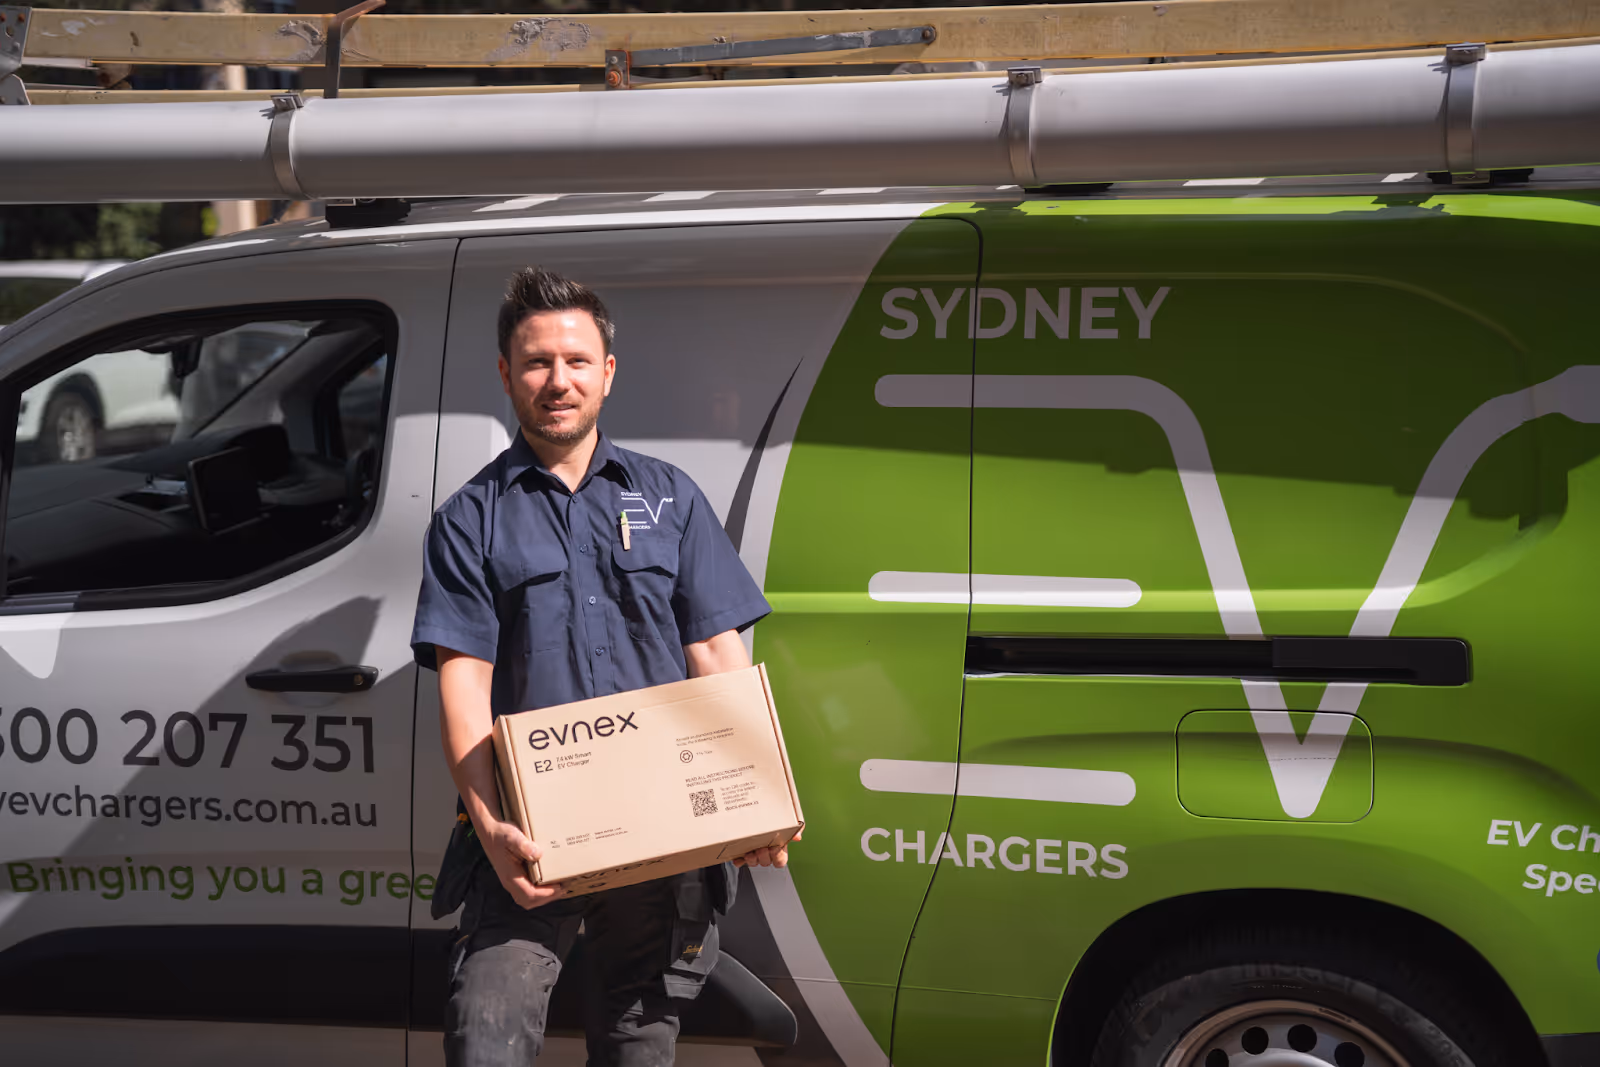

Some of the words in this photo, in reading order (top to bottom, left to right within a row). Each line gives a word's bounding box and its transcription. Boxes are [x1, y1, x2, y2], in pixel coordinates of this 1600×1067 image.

[880, 286, 1170, 339] SYDNEY
[120, 710, 248, 768] 207
[270, 714, 375, 773] 351
[528, 711, 639, 750] evnex
[534, 759, 553, 773] E2
[574, 751, 592, 760] Smart
[557, 762, 566, 770] EV
[566, 758, 590, 768] Charger
[860, 827, 1129, 880] CHARGERS
[1487, 819, 1542, 847] EV
[1550, 824, 1600, 853] Ch
[7, 857, 194, 900] Bringing
[207, 865, 286, 901] you
[301, 868, 324, 895] a
[1522, 863, 1600, 897] Spe
